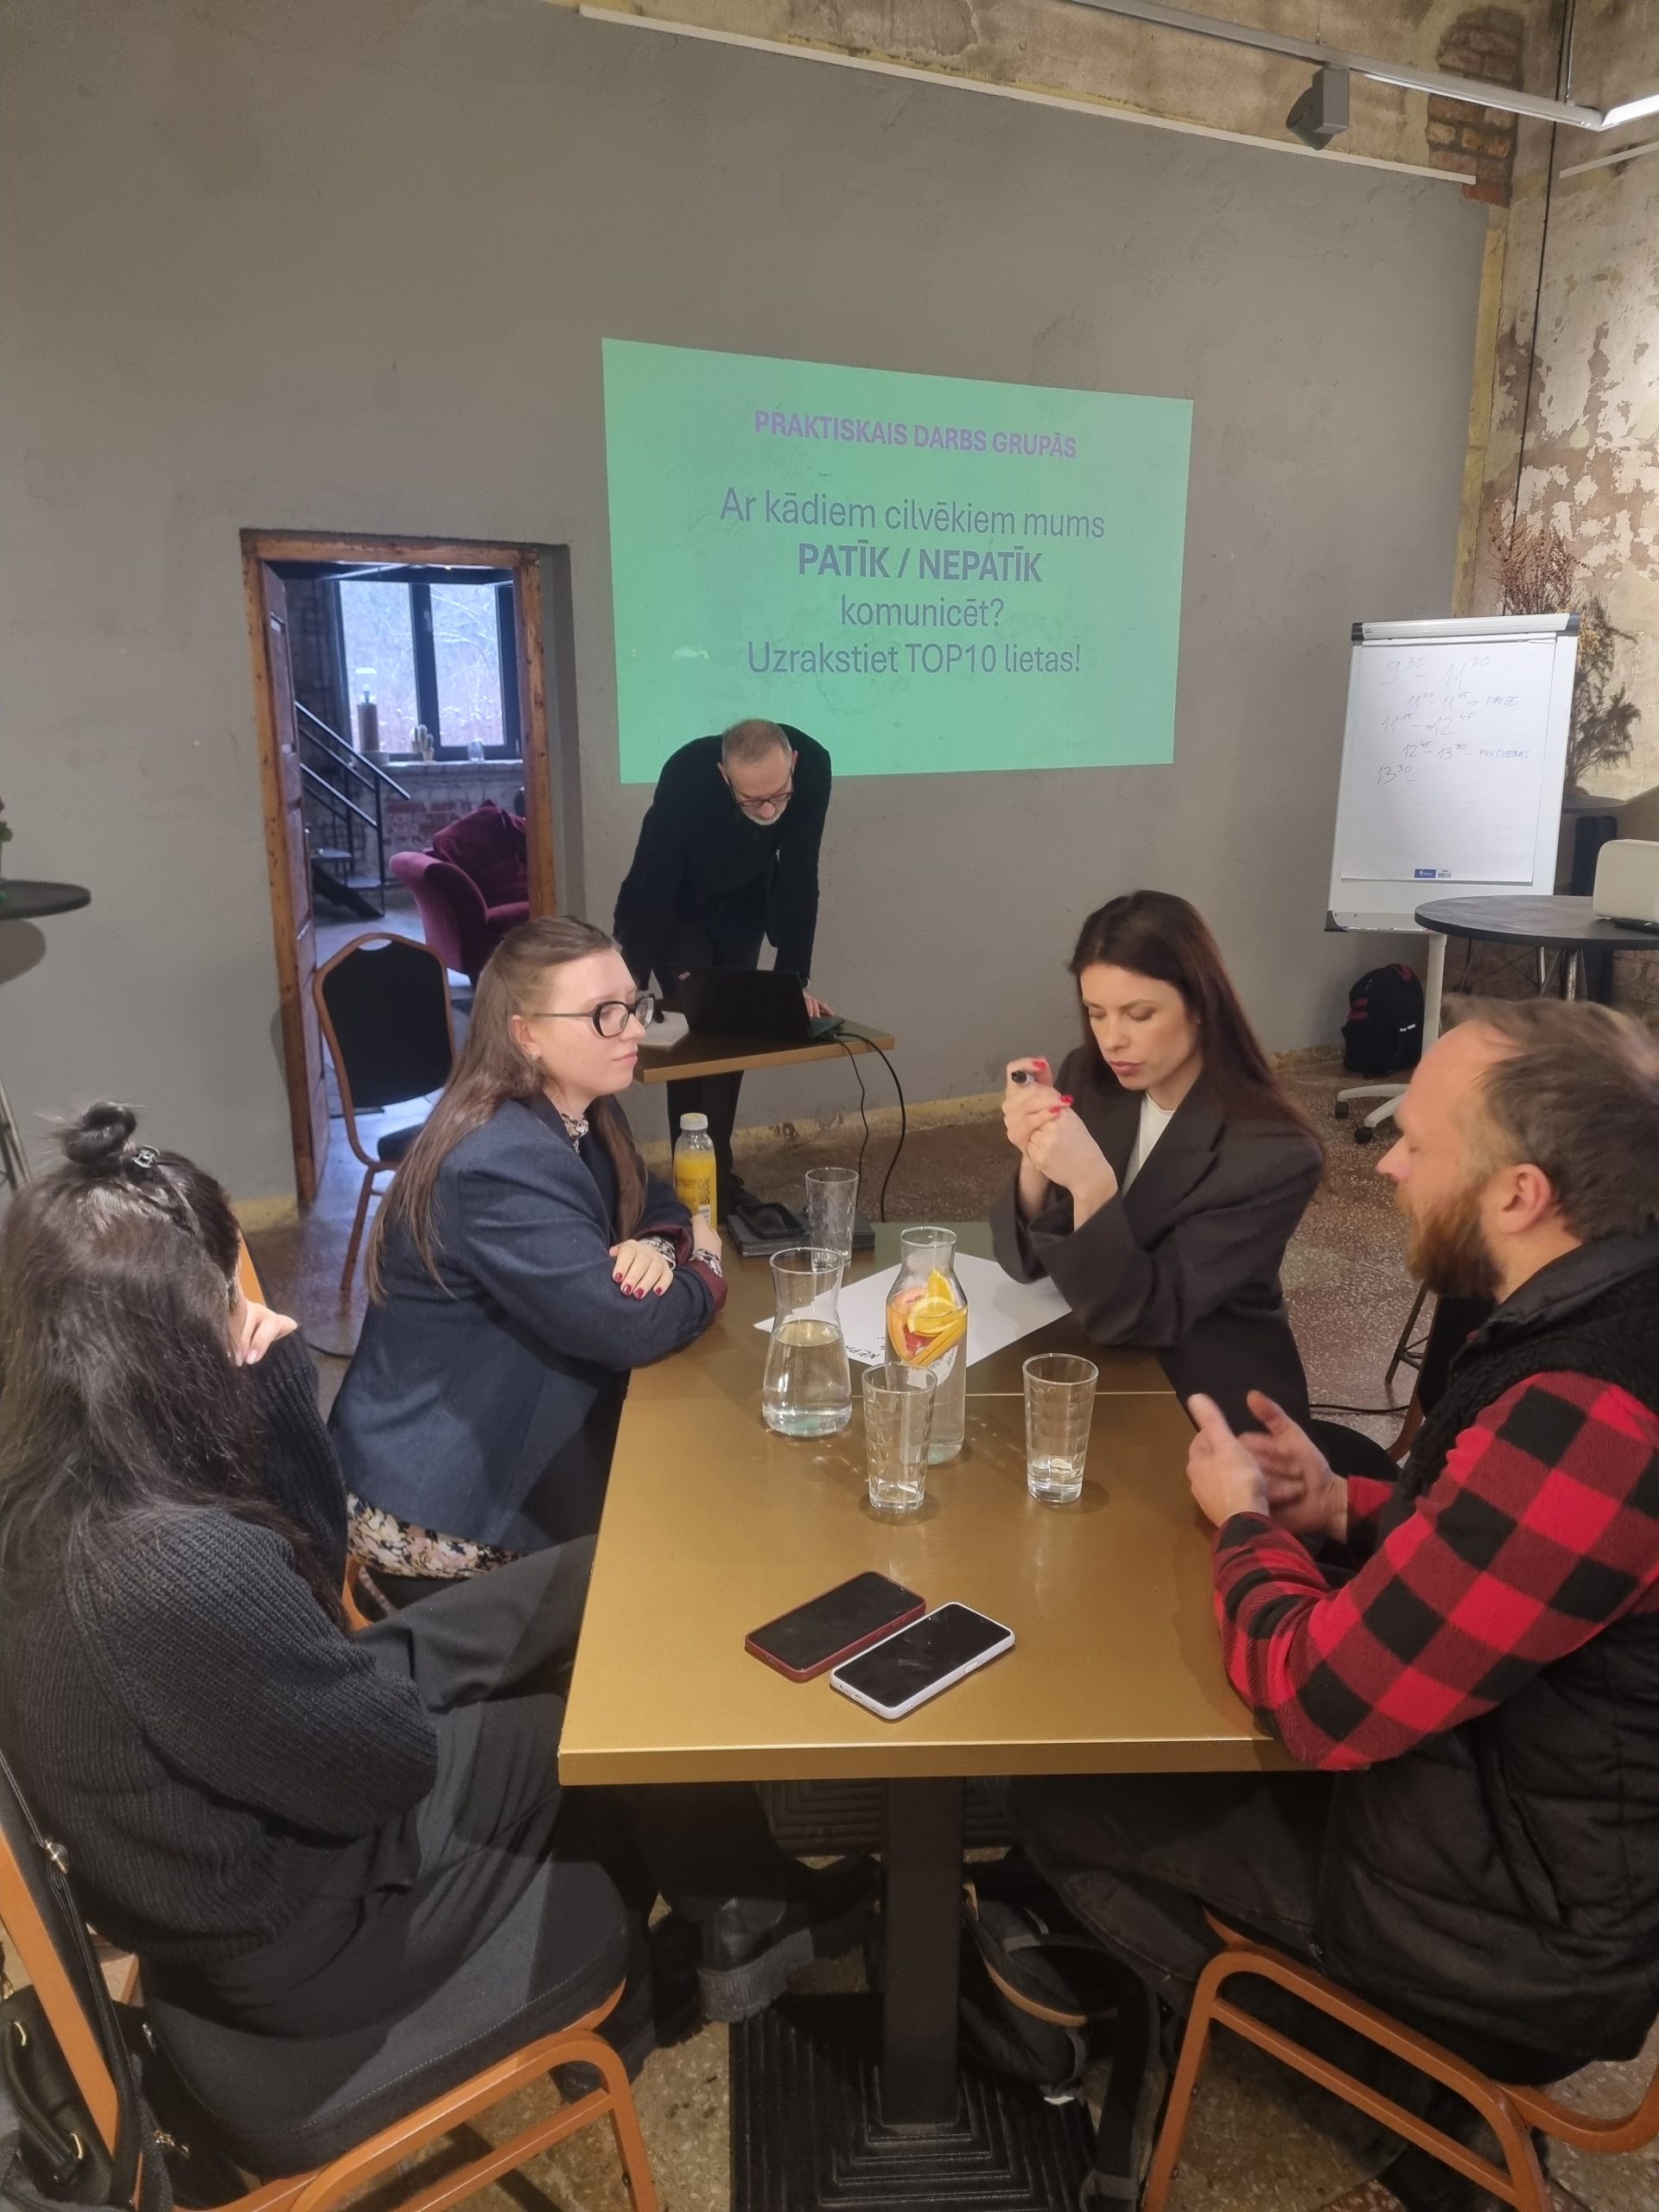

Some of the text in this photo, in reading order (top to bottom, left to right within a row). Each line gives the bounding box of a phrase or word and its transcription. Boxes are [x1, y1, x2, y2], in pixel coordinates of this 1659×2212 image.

[754, 410, 1077, 458] PRAKTISKAIS DARBS GRUPĀS
[720, 486, 1105, 538] Ar kādiem cilvēkiem mums
[798, 538, 891, 578] PATĪK
[918, 545, 1043, 582] NEPATĪK
[841, 594, 1004, 627] komunicēt?
[748, 641, 1081, 673] Uzrakstiet TOP10 lietas!
